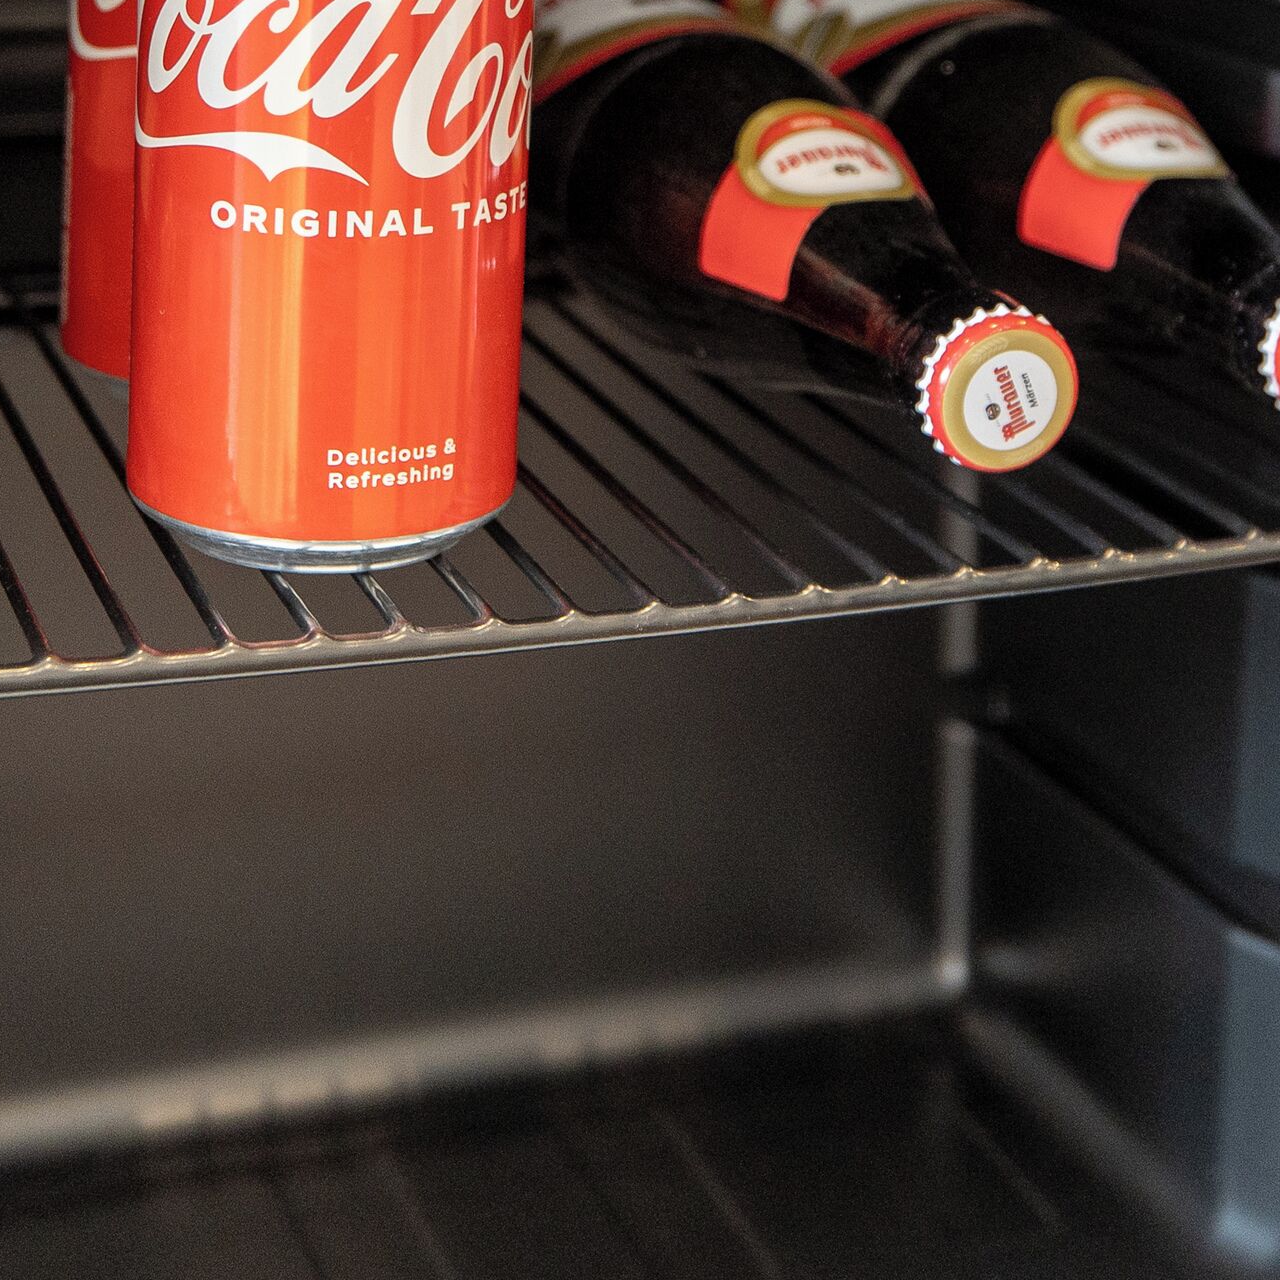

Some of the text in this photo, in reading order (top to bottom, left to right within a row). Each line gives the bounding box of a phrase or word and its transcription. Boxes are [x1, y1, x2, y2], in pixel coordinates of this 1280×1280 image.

[209, 179, 527, 239] ORIGINAL TASTE
[992, 364, 1036, 442] Murauer
[1021, 372, 1039, 409] Märzen
[326, 437, 457, 466] Delicious &
[327, 463, 455, 489] Refreshing
